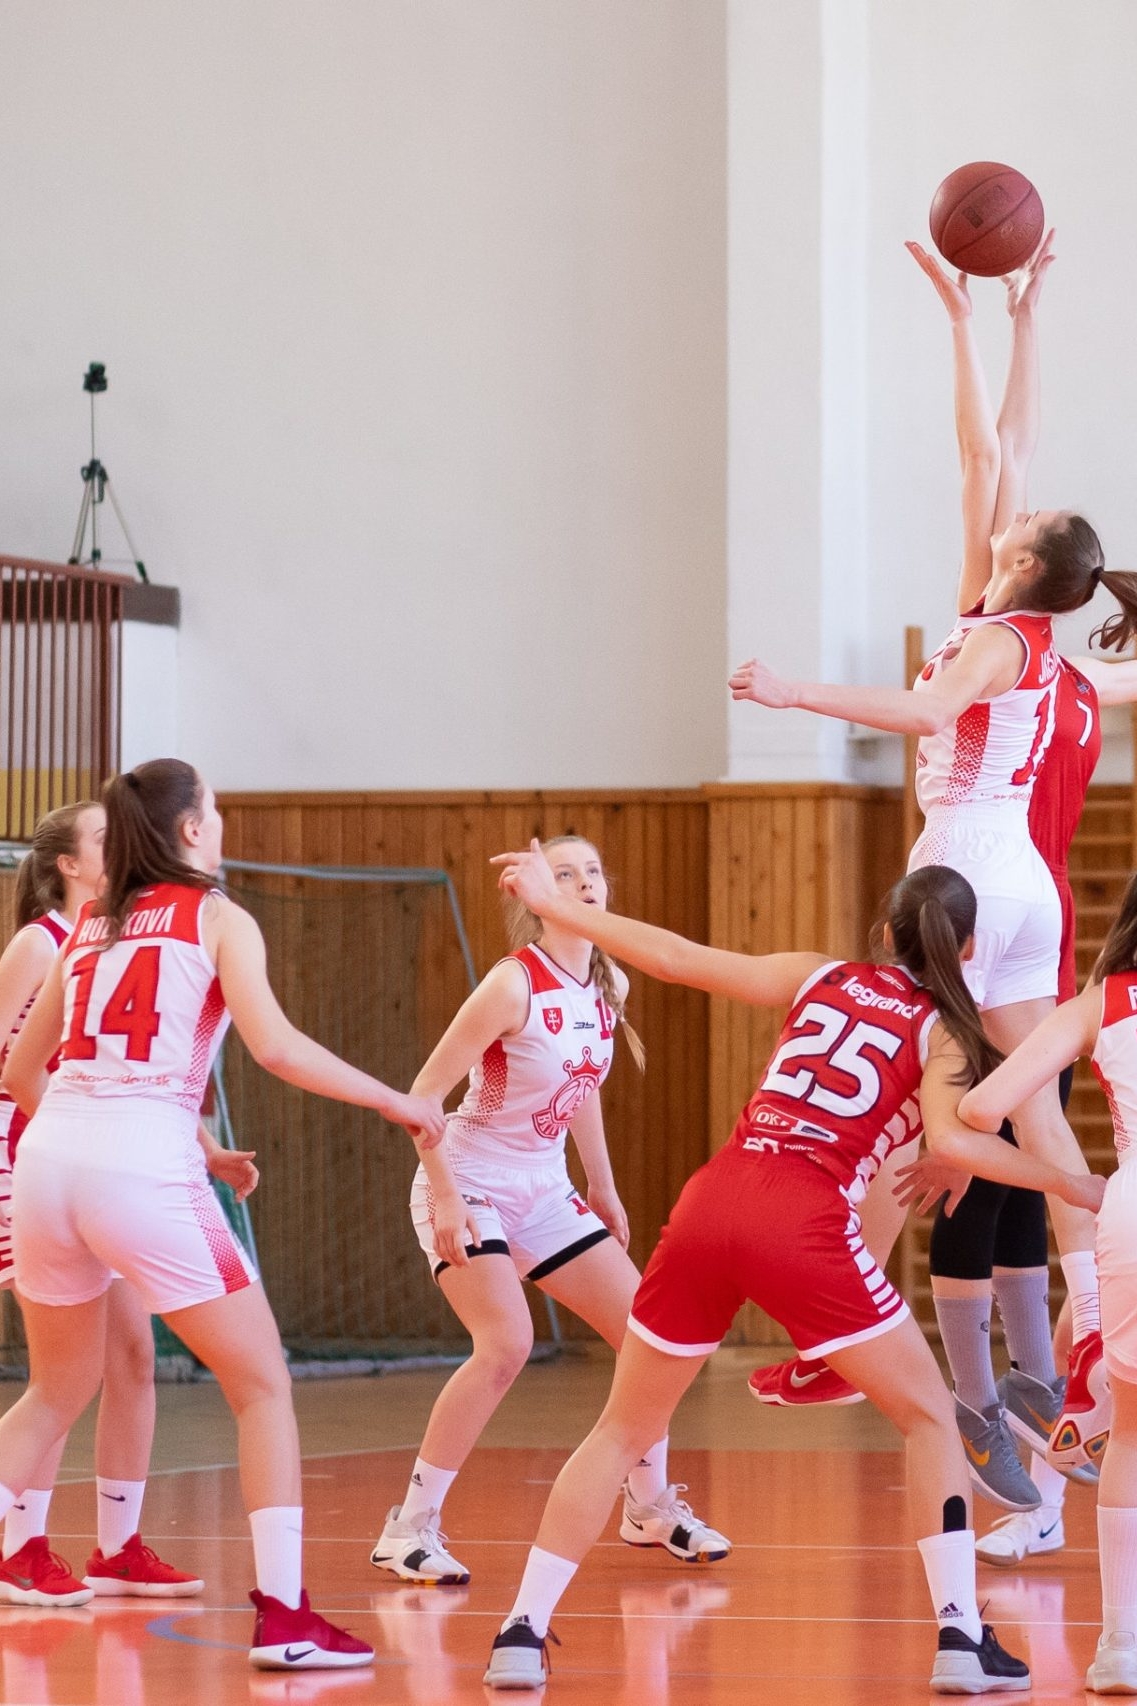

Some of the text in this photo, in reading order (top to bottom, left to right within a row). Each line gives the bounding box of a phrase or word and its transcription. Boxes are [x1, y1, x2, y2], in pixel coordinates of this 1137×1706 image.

[75, 902, 178, 945] HOKOVÁ
[61, 945, 163, 1063] 14
[840, 975, 922, 1020] legrand
[760, 1001, 904, 1119] 25
